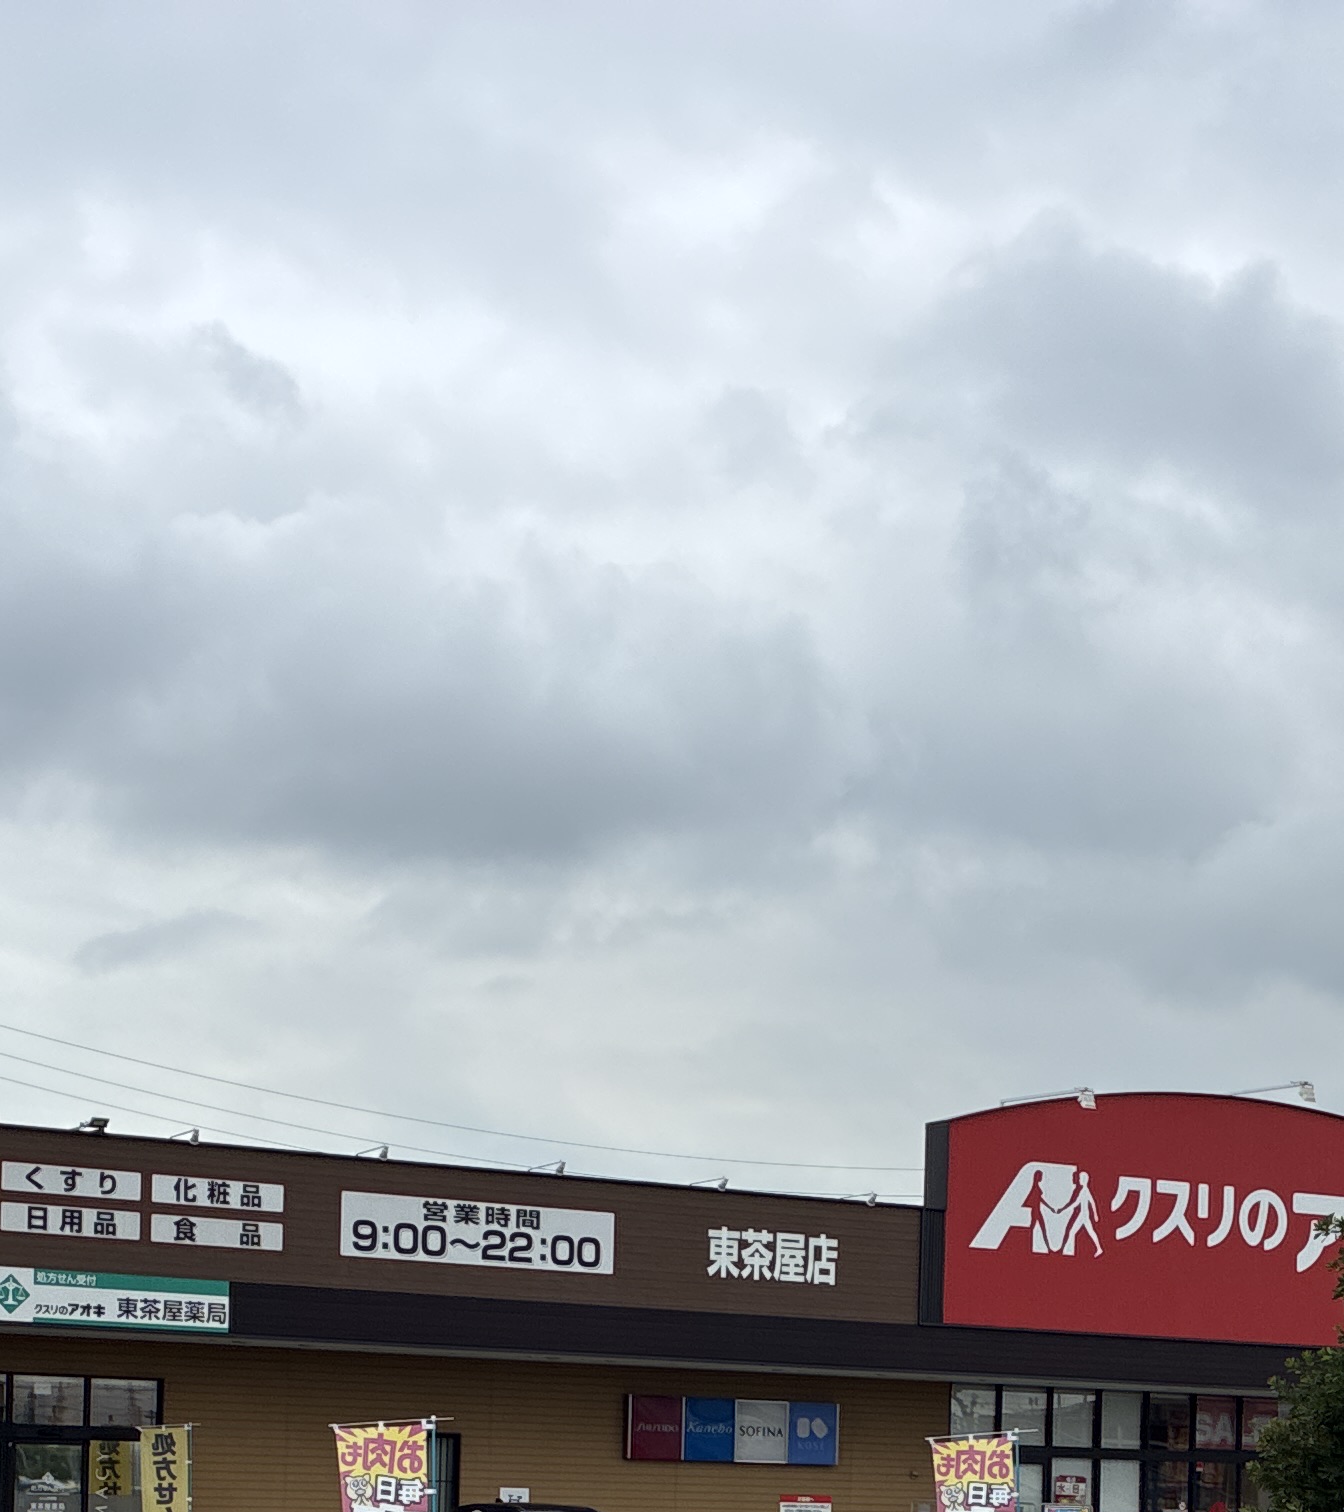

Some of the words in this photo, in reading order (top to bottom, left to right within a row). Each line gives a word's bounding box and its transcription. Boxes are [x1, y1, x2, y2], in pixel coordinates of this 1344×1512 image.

[23, 1165, 118, 1195] くすり
[172, 1177, 263, 1209] 化粧品
[24, 1204, 118, 1238] 日用品
[421, 1199, 542, 1231] 営業時間
[706, 1226, 840, 1286] 東茶屋店
[36, 1271, 97, 1287] 処方せん受付
[33, 1302, 106, 1318] クスリのアオキ
[116, 1297, 228, 1325] 東茶屋薬局
[686, 1420, 733, 1436] Kanebo
[738, 1425, 784, 1439] SOFINA
